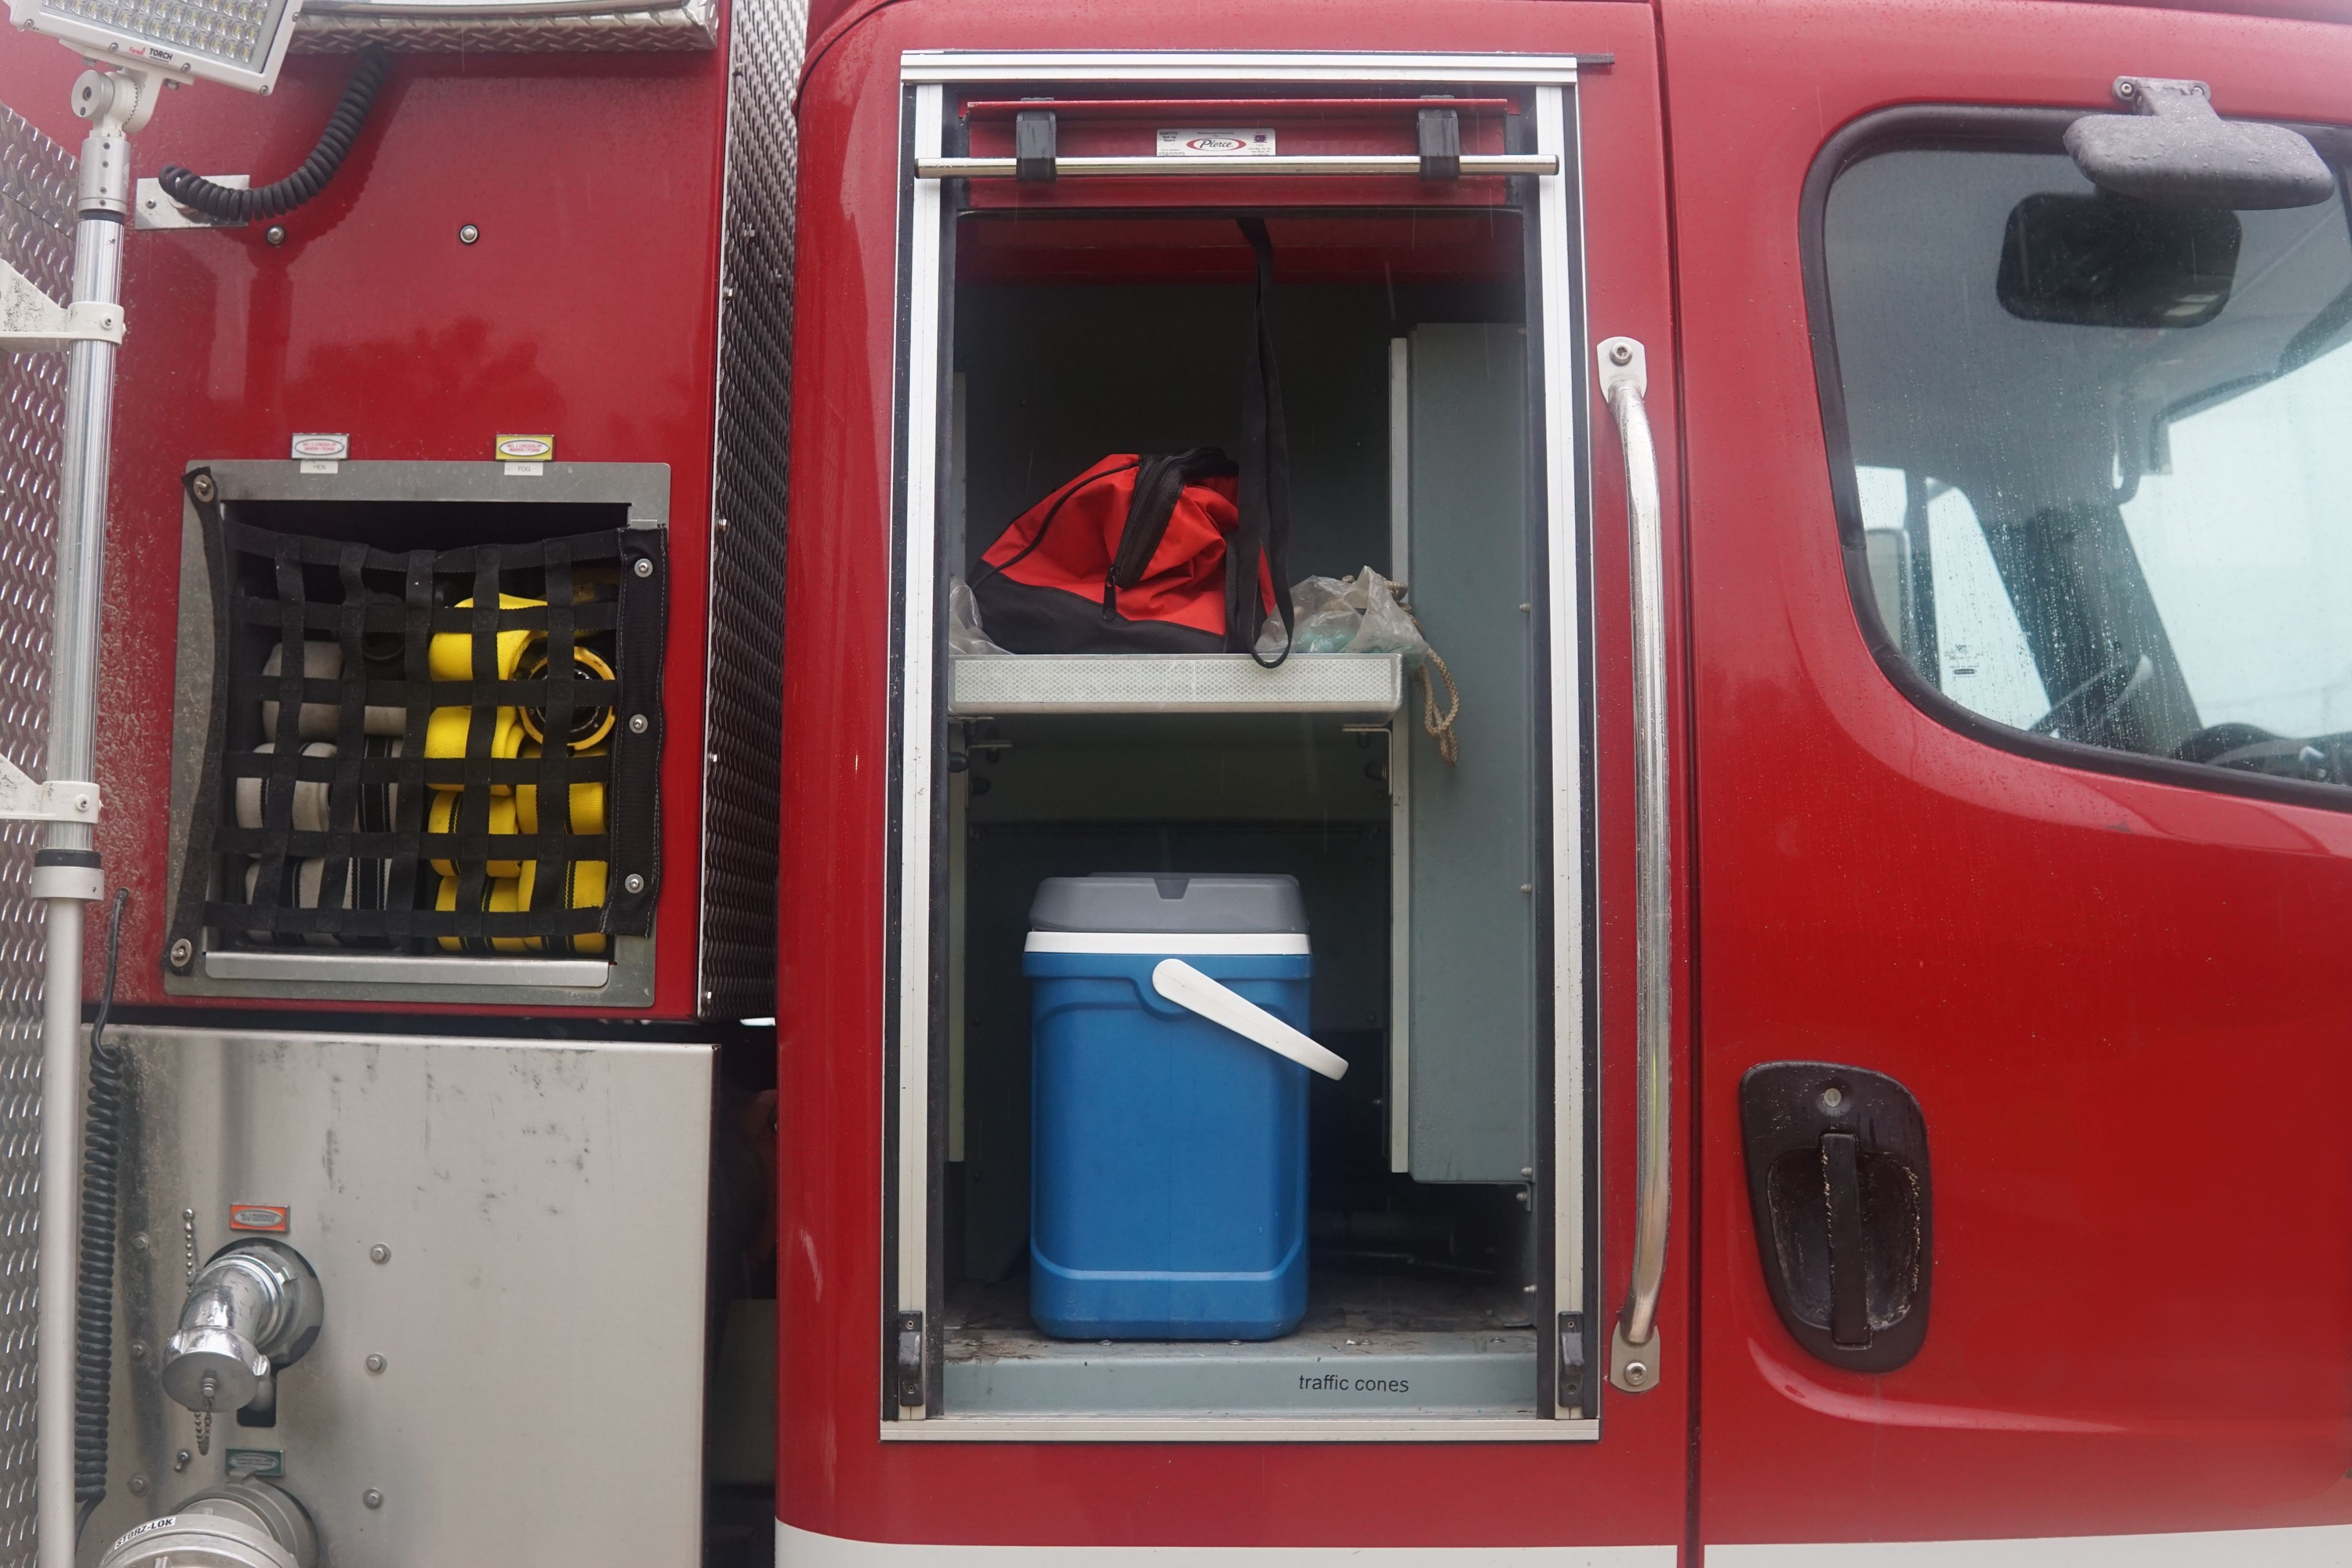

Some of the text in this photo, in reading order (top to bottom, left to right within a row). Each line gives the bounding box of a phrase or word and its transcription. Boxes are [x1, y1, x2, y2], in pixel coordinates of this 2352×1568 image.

[149, 48, 173, 60] TORCH
[1200, 139, 1232, 148] Pierce
[1299, 1374, 1409, 1393] traffic cones
[116, 1518, 173, 1548] STORZ-LOK
